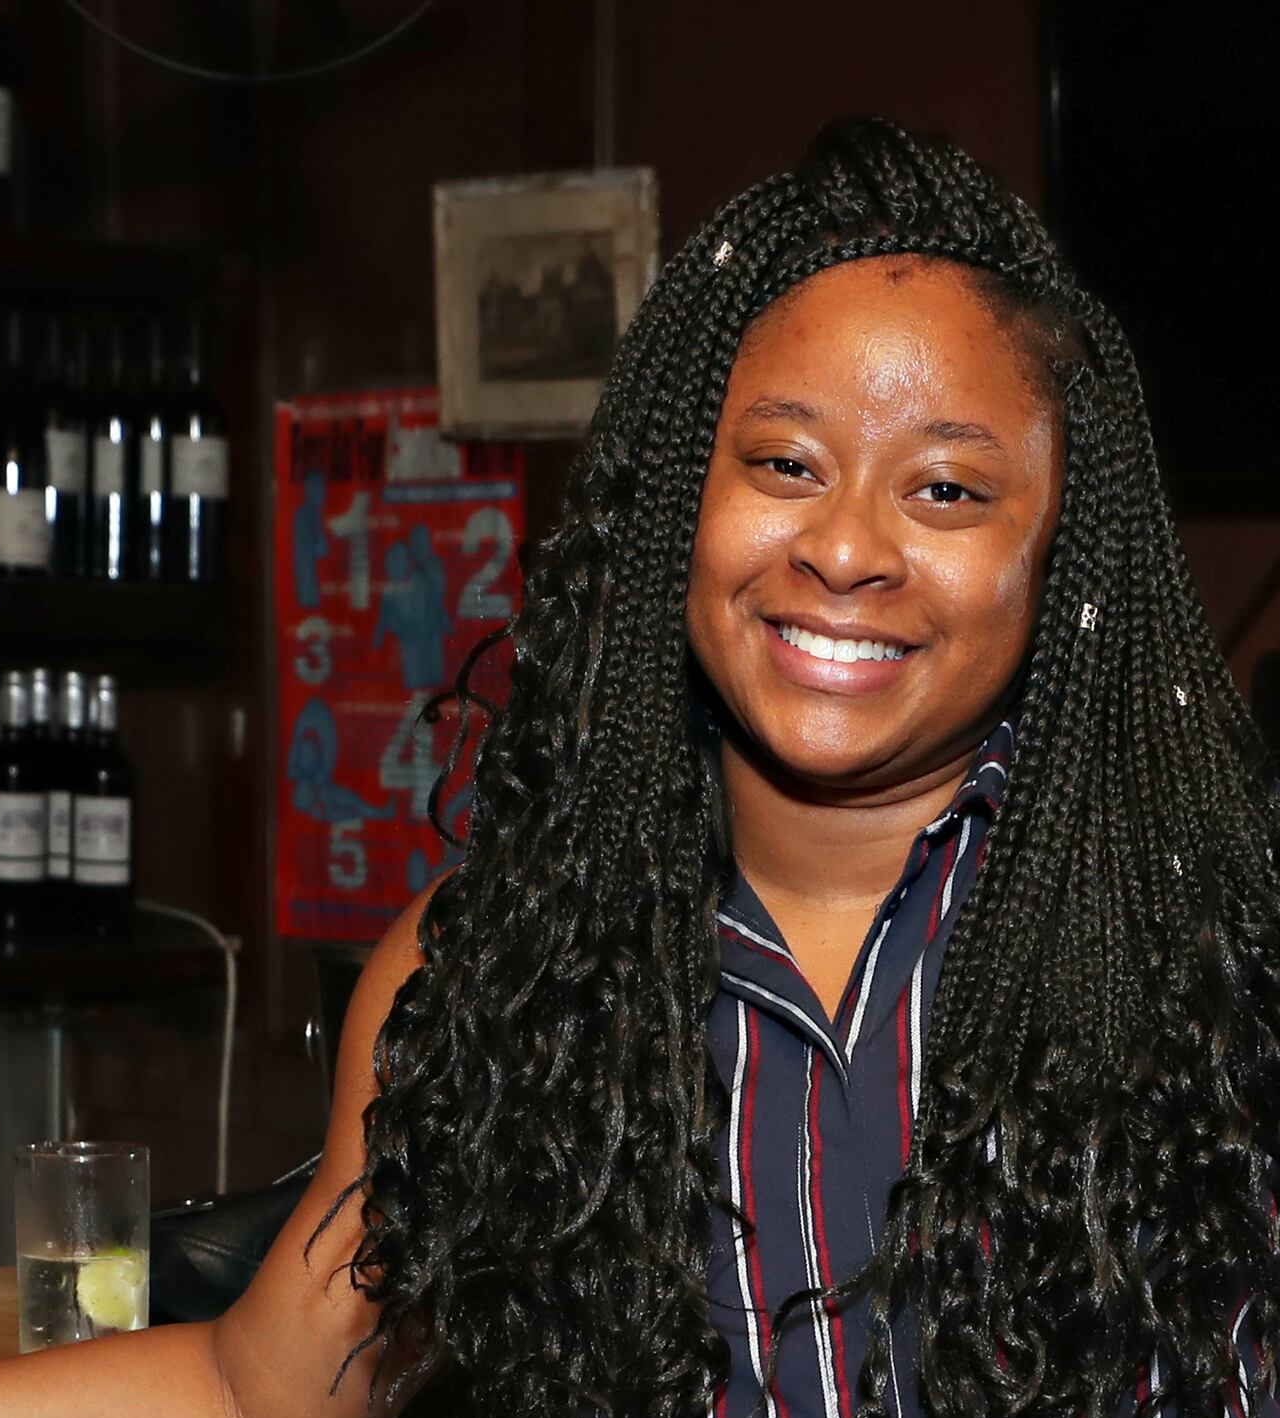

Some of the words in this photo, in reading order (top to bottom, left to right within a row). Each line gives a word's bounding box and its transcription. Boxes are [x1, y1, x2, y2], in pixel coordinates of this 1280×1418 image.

[328, 491, 371, 610] 1
[458, 507, 514, 618] 2
[295, 616, 331, 685] 3
[379, 690, 446, 819] 4
[327, 819, 368, 891] 5
